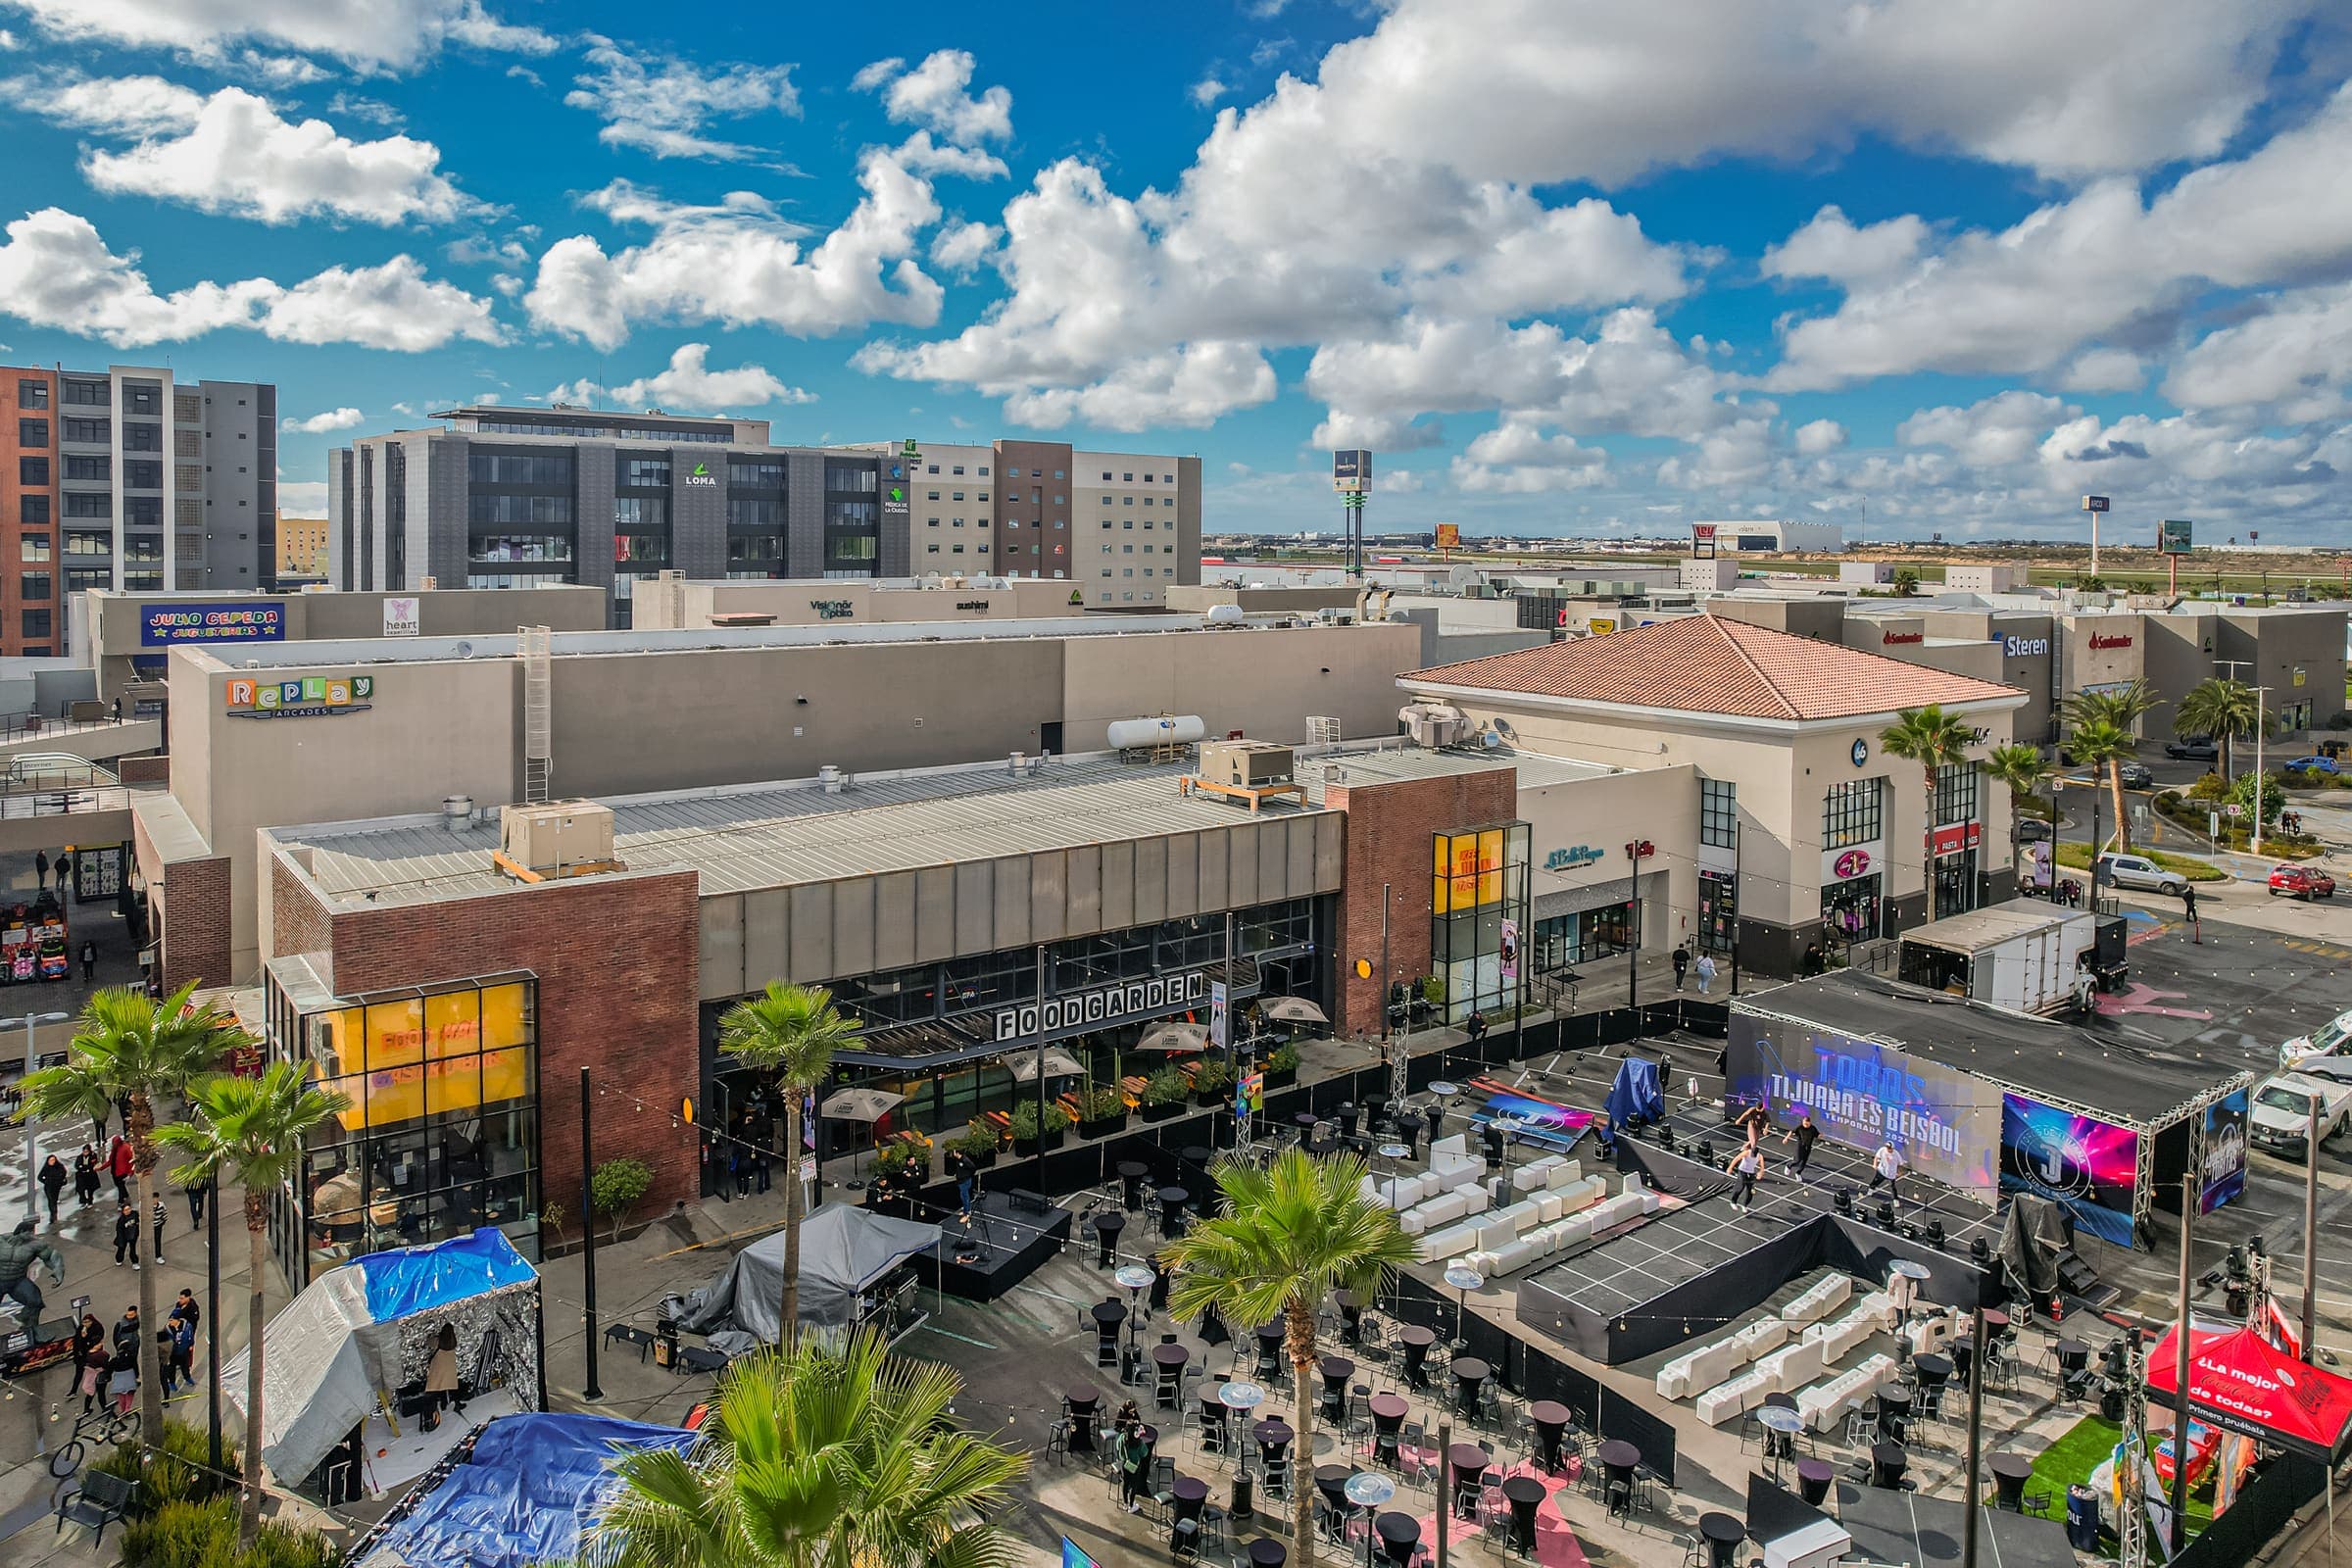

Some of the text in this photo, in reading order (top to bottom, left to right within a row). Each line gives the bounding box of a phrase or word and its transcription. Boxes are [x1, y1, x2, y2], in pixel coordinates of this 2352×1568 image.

[685, 476, 716, 485] LOMA
[150, 611, 278, 626] JULIO CEPEDA
[386, 620, 416, 629] heart
[2007, 635, 2047, 657] Steren
[276, 707, 328, 718] ARCADES
[1941, 834, 1979, 852] PASTA NGS
[999, 972, 1203, 1039] FOODGARDEN
[1771, 1073, 1963, 1157] TIJUANA ES BEISBOL
[1825, 1111, 1883, 1137] TEMPORADA
[2197, 1357, 2280, 1392] ¿La mejor
[2190, 1386, 2273, 1420] de todas?
[2188, 1402, 2266, 1438] Primero pruébala
